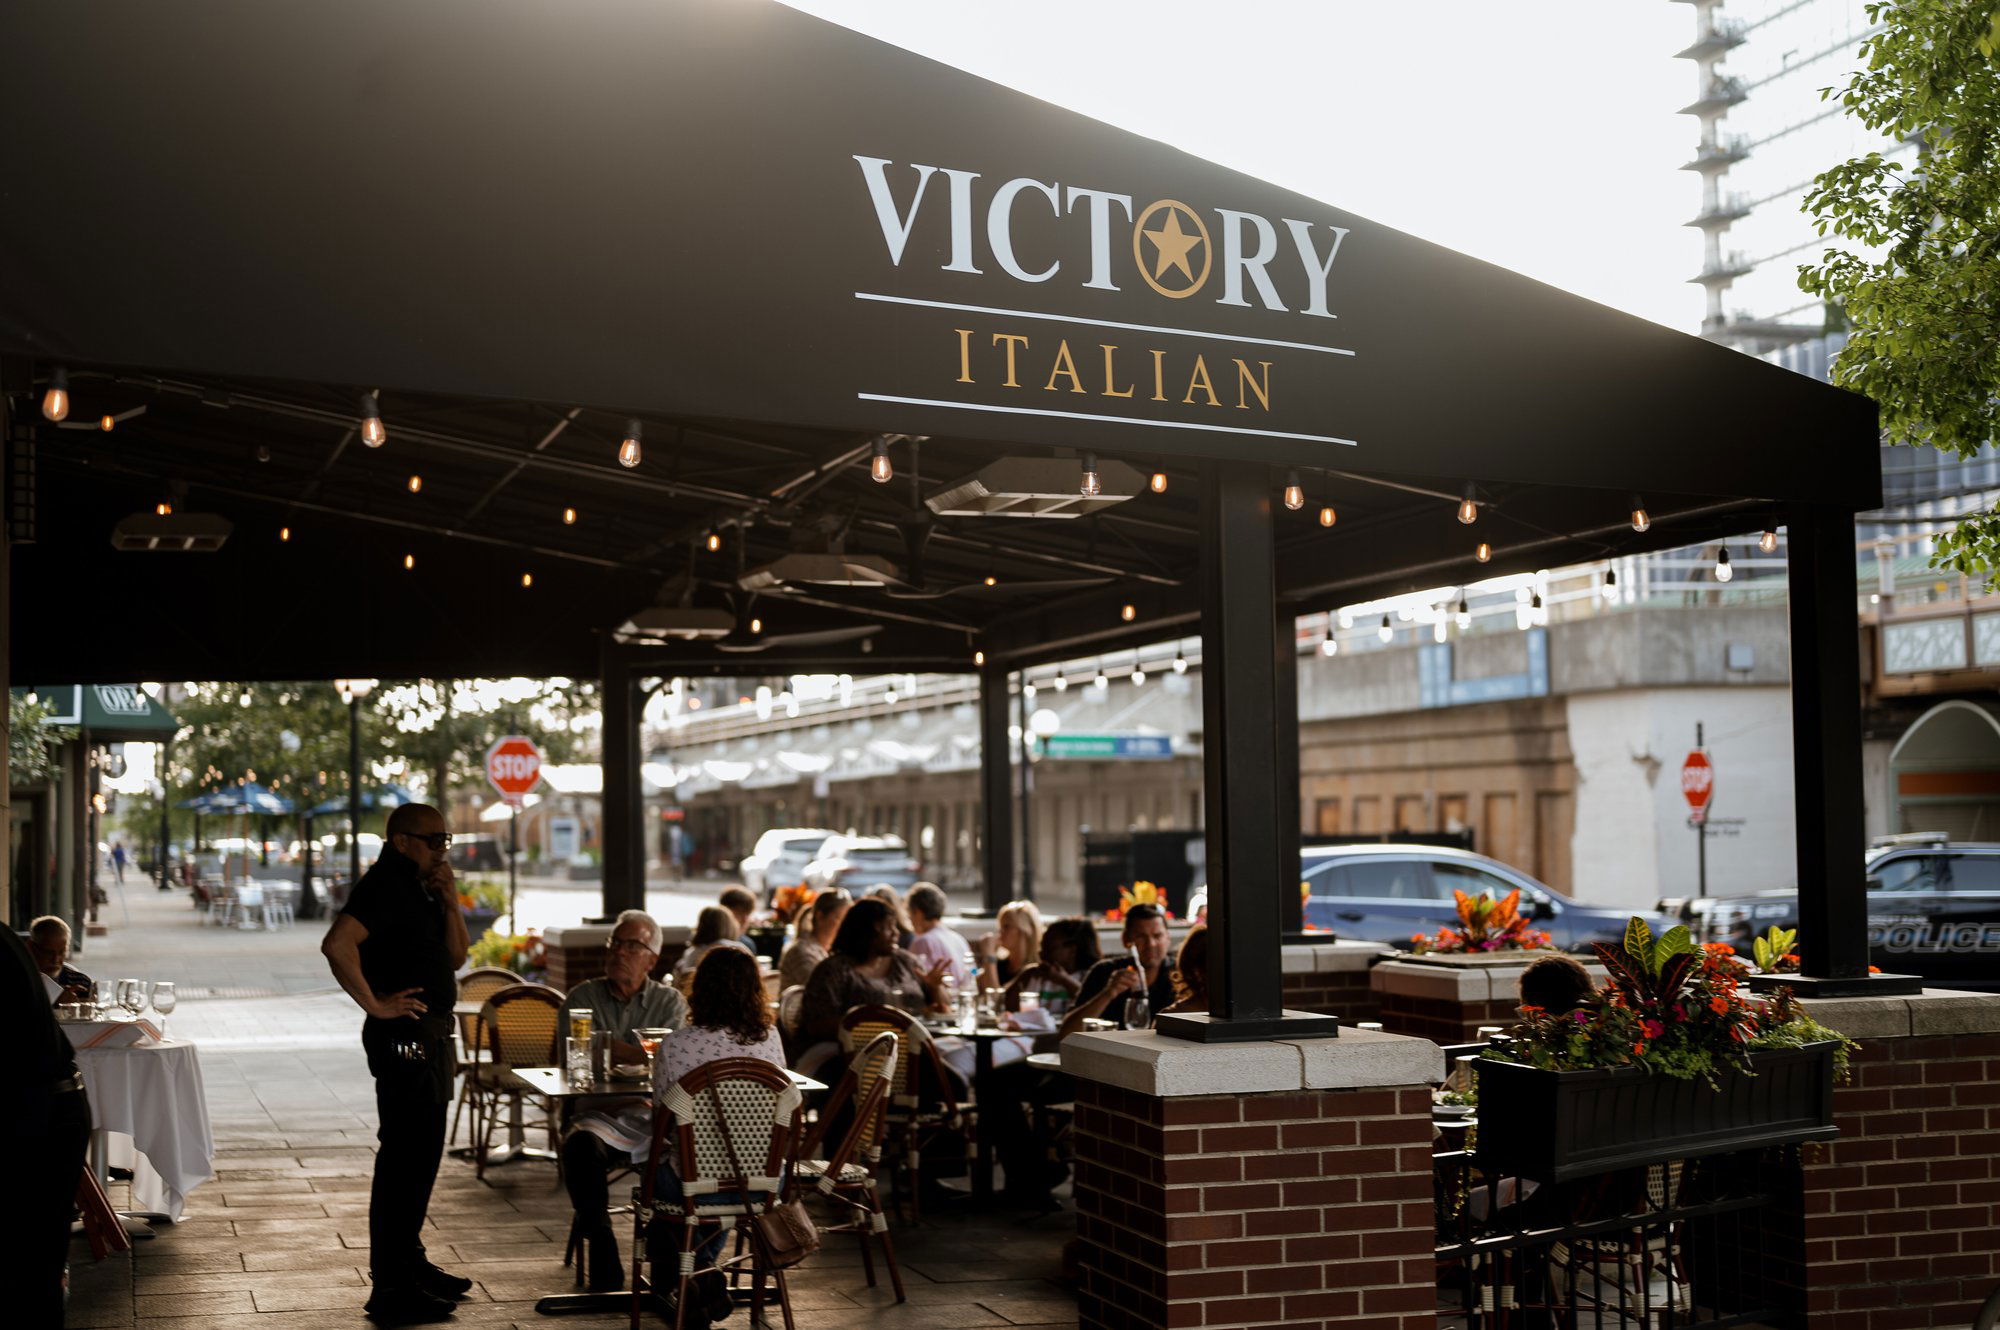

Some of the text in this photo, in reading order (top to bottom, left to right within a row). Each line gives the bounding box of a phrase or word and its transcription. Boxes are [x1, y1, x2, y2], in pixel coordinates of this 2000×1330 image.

[852, 154, 1350, 319] VICTORY
[954, 329, 1273, 411] ITALIAN
[494, 755, 540, 780] STOP
[1682, 767, 1712, 792] STOP
[1867, 922, 2000, 953] POLICE
